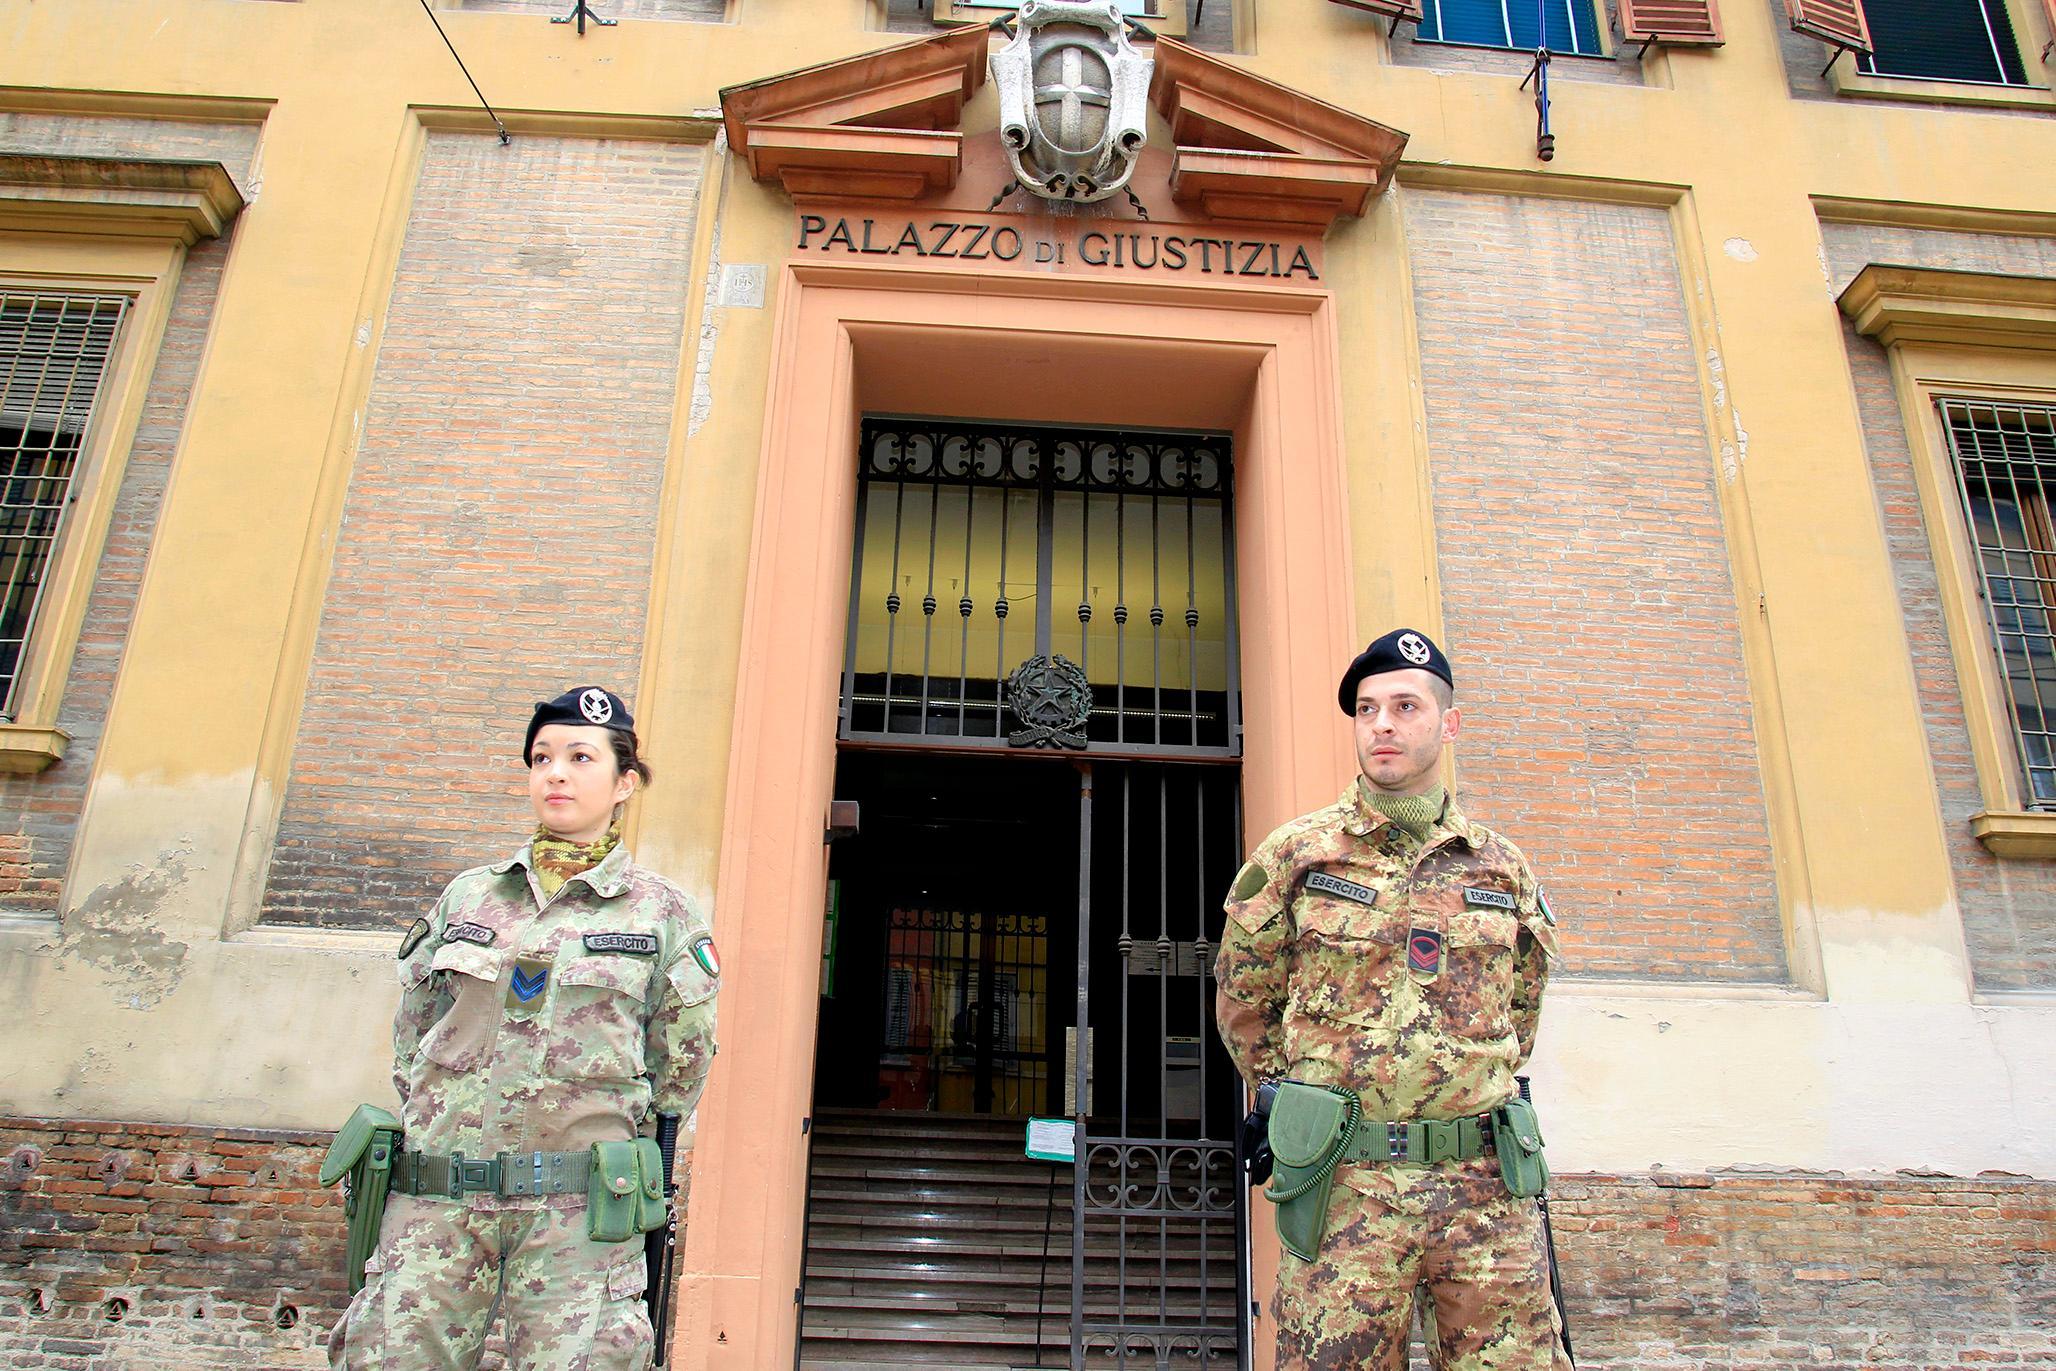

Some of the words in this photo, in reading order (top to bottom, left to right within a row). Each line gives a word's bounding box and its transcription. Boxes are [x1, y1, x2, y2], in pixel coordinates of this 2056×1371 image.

[797, 215, 1023, 262] PALAZZO
[1034, 241, 1065, 265] DI
[1078, 232, 1320, 280] GIUSTIZIA
[1311, 875, 1369, 899] ESERCITO
[1470, 890, 1508, 906] ESERCITO
[447, 925, 487, 939] ECITO
[593, 936, 649, 950] ESERCITO
